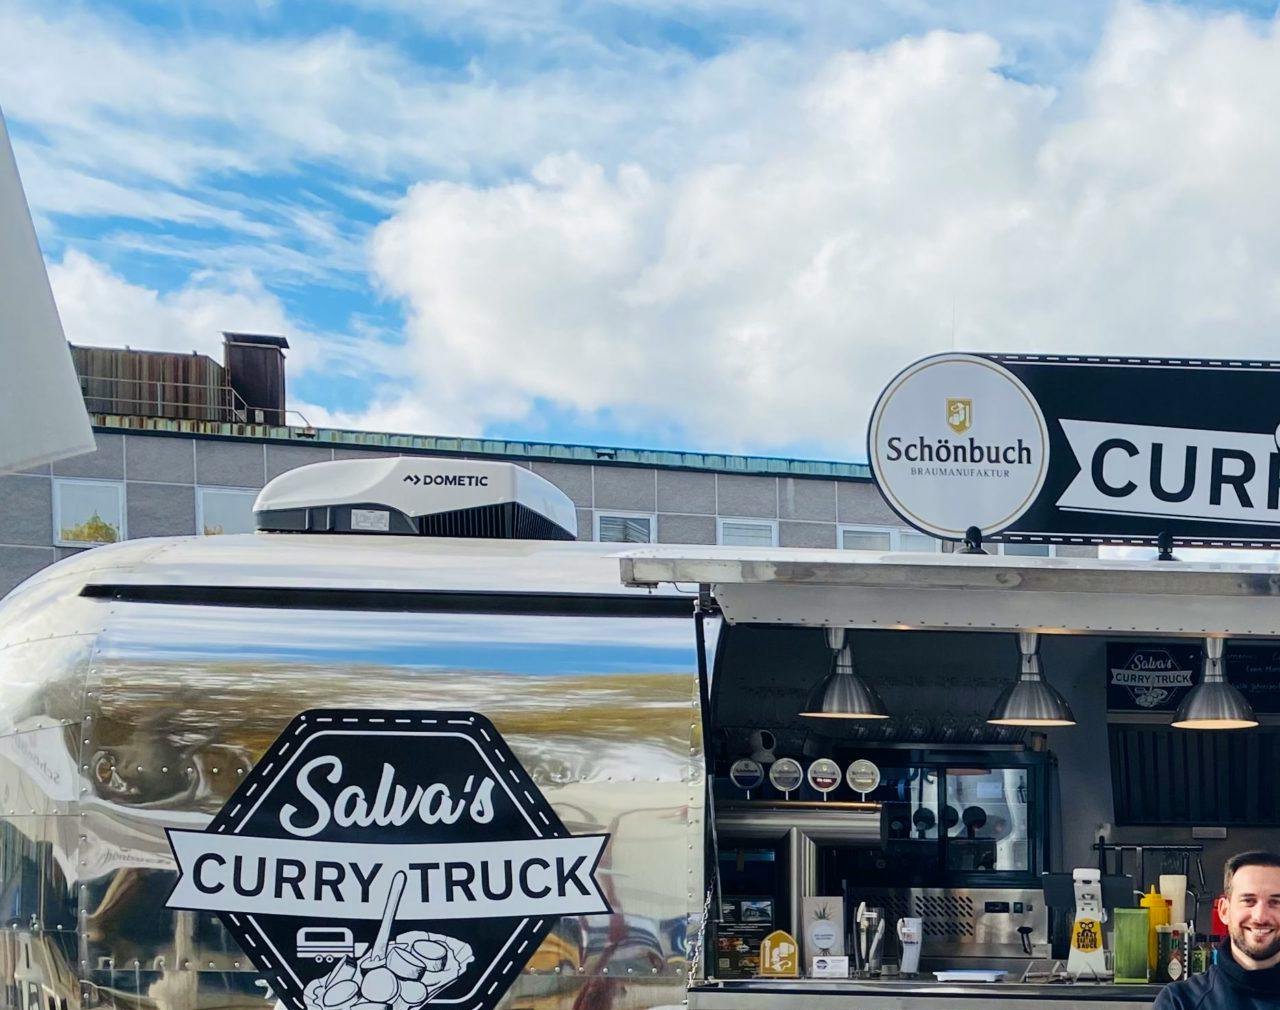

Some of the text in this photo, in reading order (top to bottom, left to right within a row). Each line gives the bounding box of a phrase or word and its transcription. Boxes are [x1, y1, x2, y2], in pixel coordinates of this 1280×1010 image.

[887, 436, 1032, 464] Schönbuch
[911, 467, 1010, 478] BRAUMANUFAKTUR
[423, 474, 488, 487] DOMETIC
[1131, 655, 1173, 670] Salva's
[1115, 673, 1189, 683] CURRY TRUCK
[279, 755, 495, 837] Salva's
[192, 852, 589, 903] CURRY TRUCK
